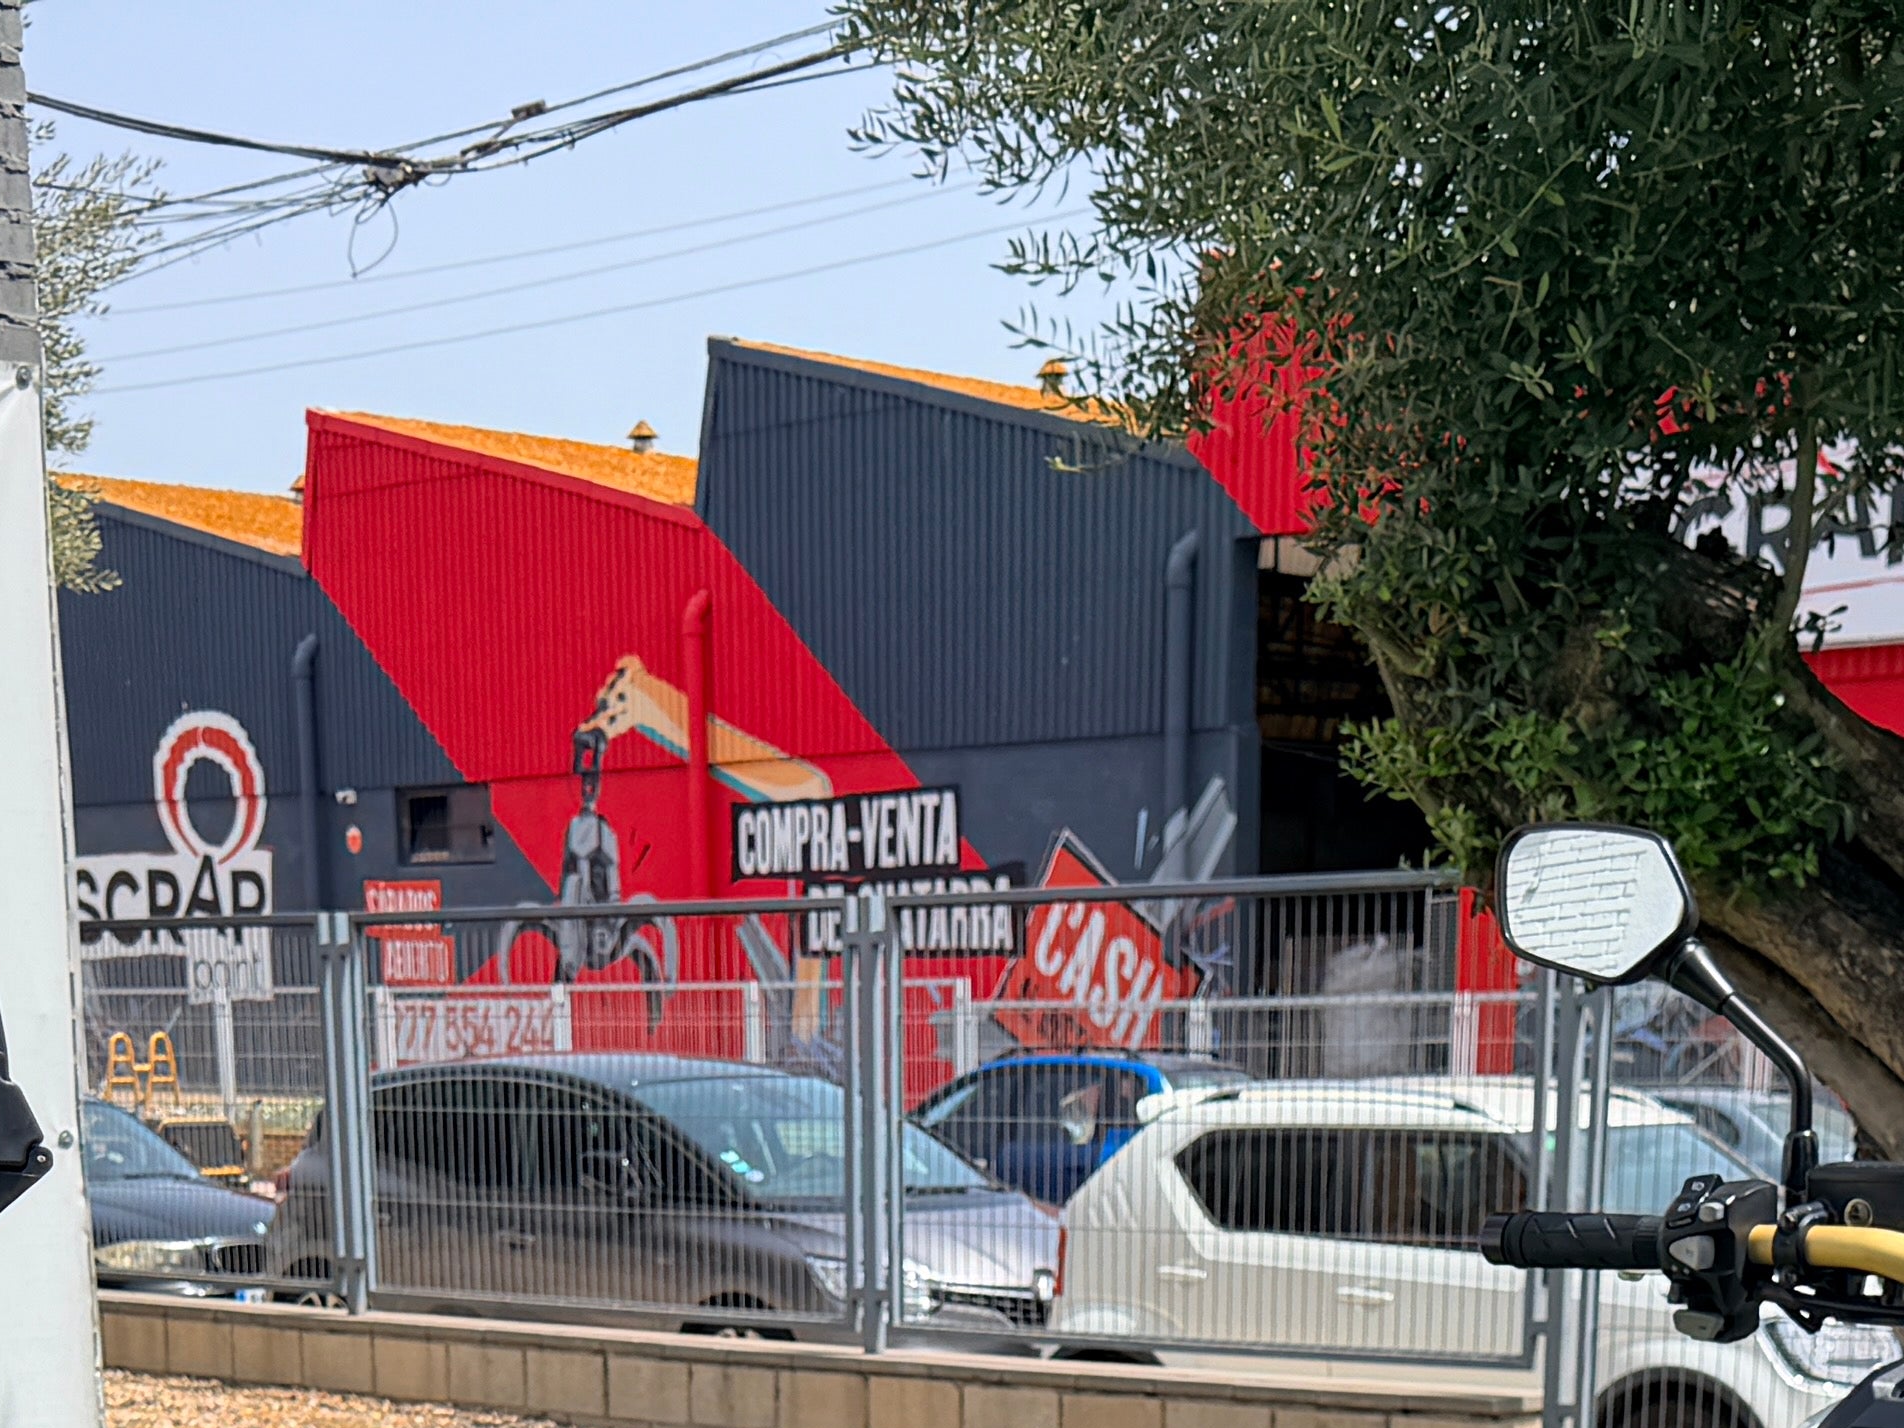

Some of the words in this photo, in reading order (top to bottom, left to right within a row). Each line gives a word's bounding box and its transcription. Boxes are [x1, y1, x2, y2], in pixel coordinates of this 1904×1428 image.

[738, 791, 959, 876] COMPRA-VENTA
[76, 854, 266, 947] SCRAP
[1034, 900, 1164, 1050] CASH
